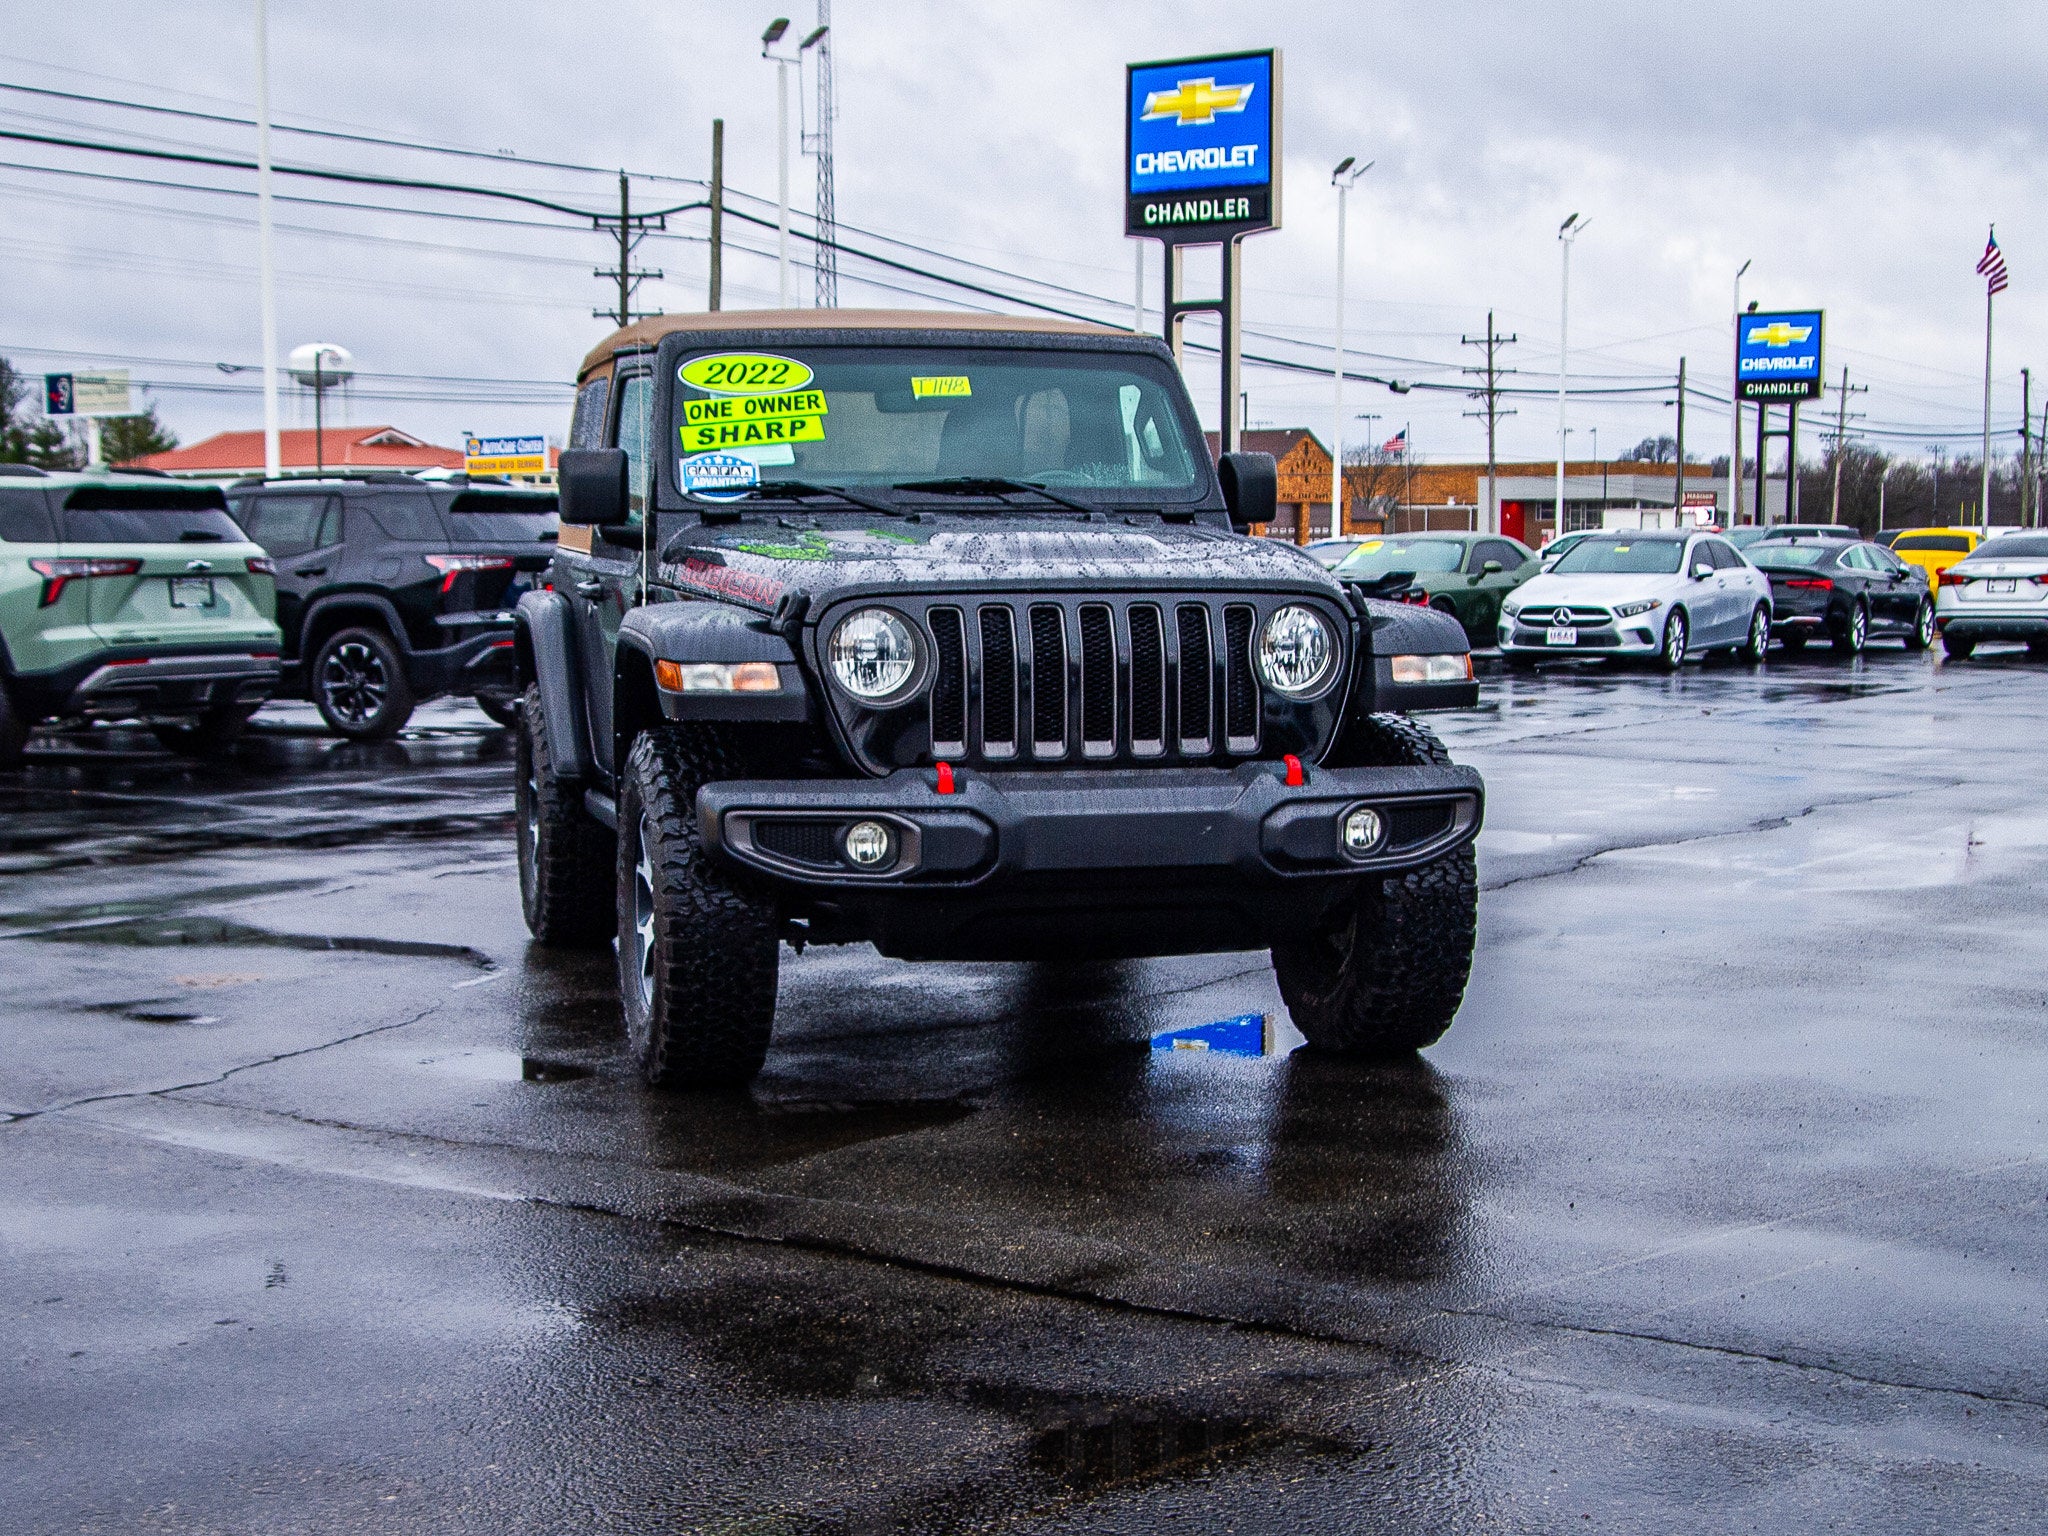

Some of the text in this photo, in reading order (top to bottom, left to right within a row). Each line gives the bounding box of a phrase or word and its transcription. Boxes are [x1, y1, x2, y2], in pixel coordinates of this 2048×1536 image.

[1135, 144, 1259, 175] CHEVROLET
[1144, 197, 1250, 225] CHANDLER
[704, 362, 790, 385] 2022
[1741, 355, 1815, 371] CHEVROLET
[1746, 382, 1809, 395] CHANDLER
[689, 394, 821, 420] ONE OWNER
[697, 420, 807, 446] SHARP
[688, 465, 752, 477] CARFAX
